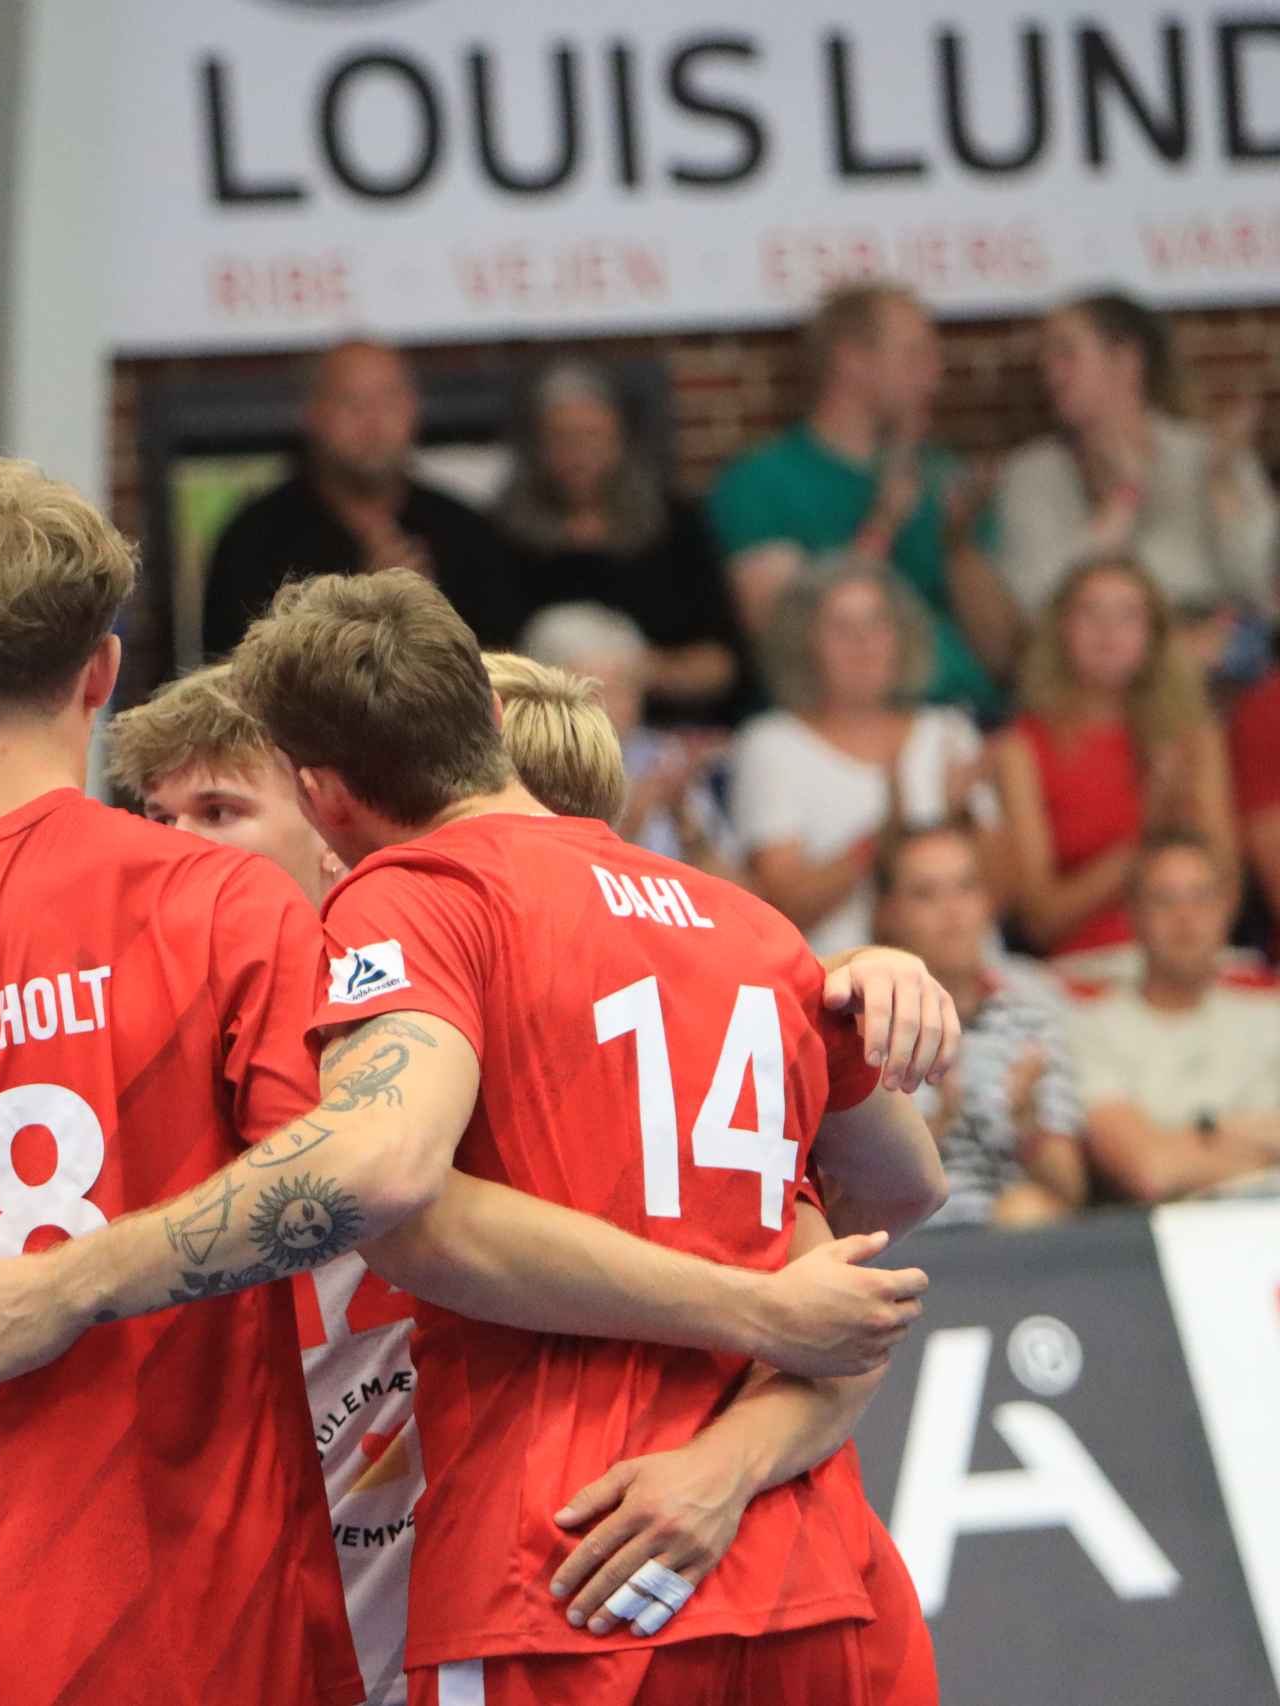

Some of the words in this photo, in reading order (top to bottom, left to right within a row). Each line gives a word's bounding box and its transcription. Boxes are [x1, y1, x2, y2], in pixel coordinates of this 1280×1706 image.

[203, 40, 767, 208] LOUIS
[209, 256, 354, 312] RIBE
[454, 242, 668, 302] VEJEN
[761, 226, 1050, 294] ESBJERG
[1142, 212, 1280, 271] VAR
[591, 864, 715, 928] DAHL
[593, 976, 798, 1231] 14
[317, 1371, 412, 1461] ULEMÆ
